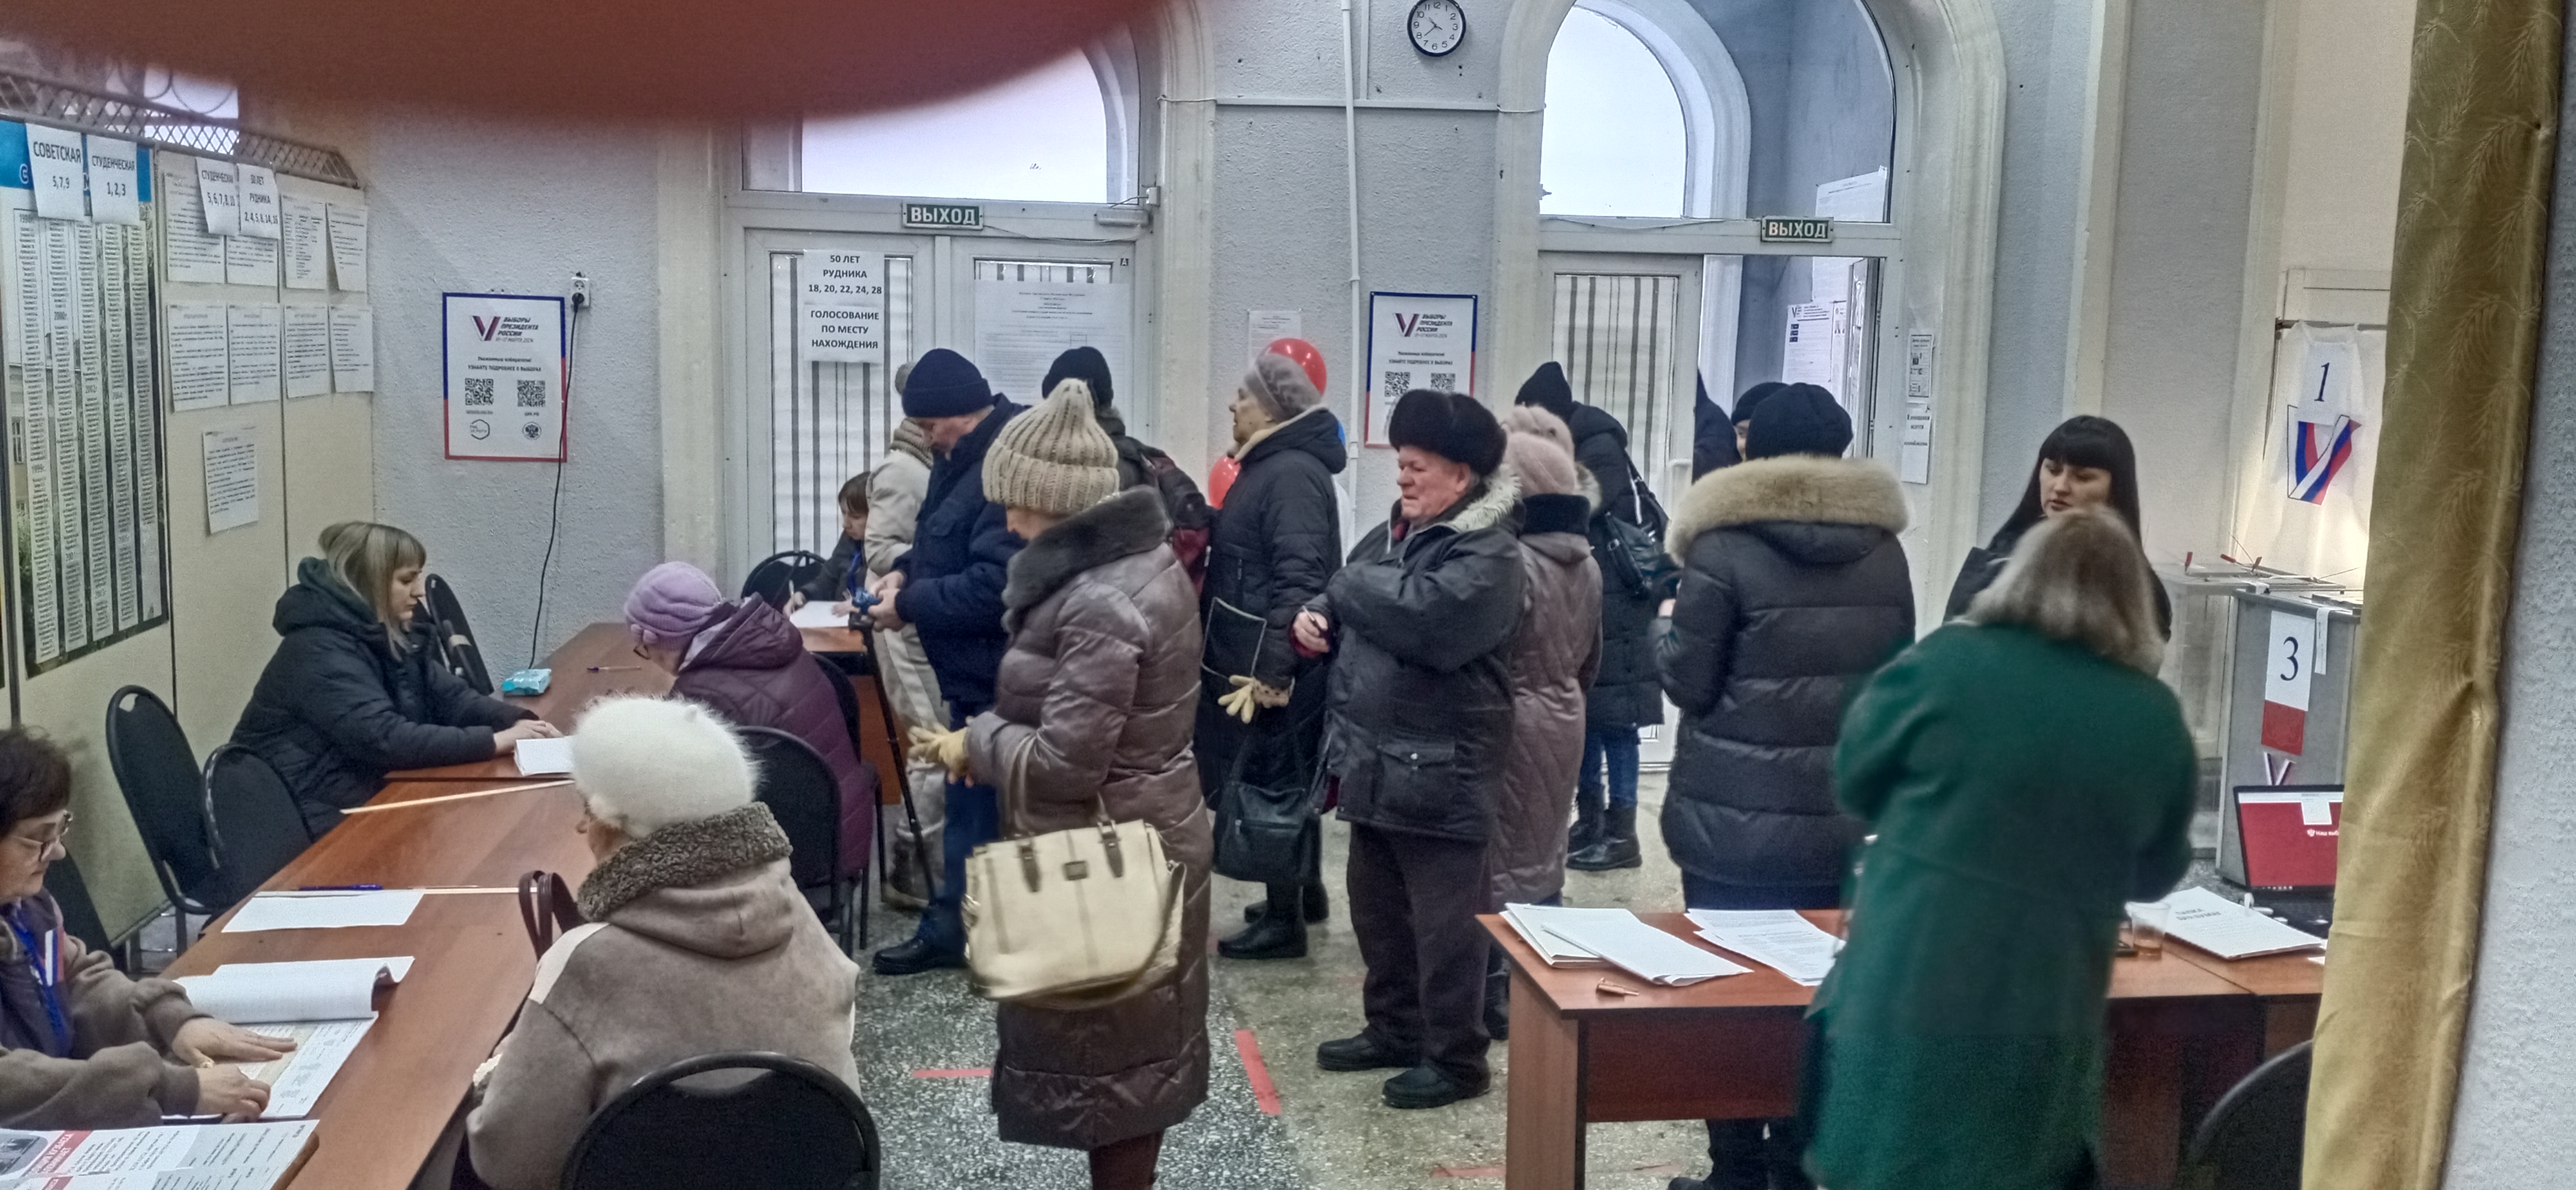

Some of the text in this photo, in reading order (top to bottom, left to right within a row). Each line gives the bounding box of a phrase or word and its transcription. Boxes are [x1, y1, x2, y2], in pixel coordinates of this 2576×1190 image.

[33, 141, 81, 163] СОВЕТСКАЯ
[92, 155, 135, 171] СТУДЕНЧЕСКАЯ
[911, 207, 976, 225] ВЫХОД
[1769, 222, 1826, 238] ВЫХОД
[823, 270, 868, 278] РУДНИКА
[809, 285, 821, 293] 18,
[824, 285, 837, 294] 20,
[840, 285, 853, 294] 22,
[855, 286, 869, 295] 24,
[811, 310, 879, 320] ГОЛОСОВАНИЕ
[838, 325, 869, 334] МЕСТУ
[812, 339, 878, 350] НАХОЖДЕНИЯ
[2314, 362, 2330, 402] 1
[2280, 636, 2299, 681] 3
